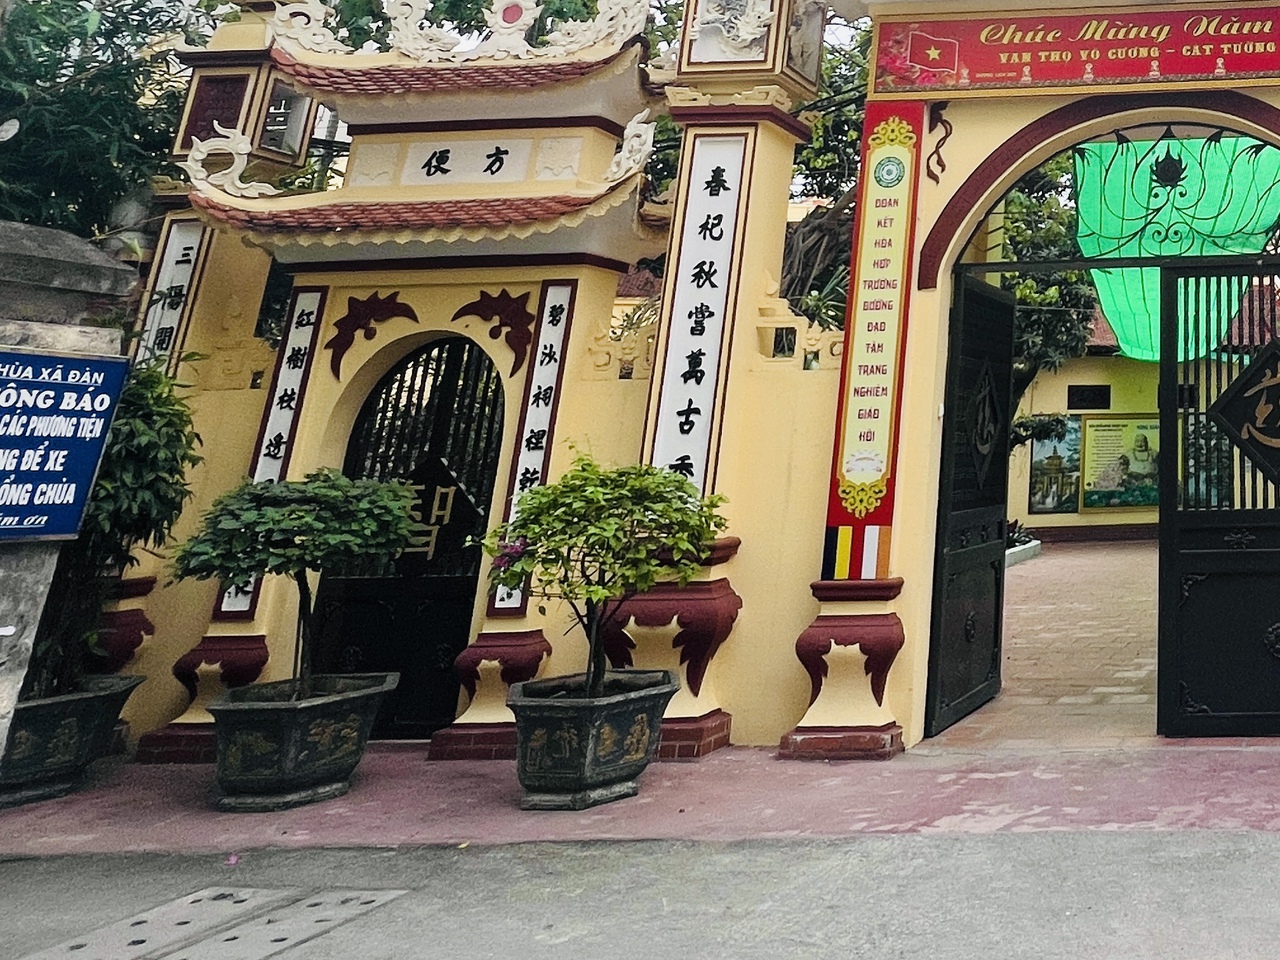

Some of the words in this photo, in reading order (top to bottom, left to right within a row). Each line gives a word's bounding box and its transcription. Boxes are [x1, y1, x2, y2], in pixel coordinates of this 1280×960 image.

[980, 23, 1063, 46] Chúc
[1068, 19, 1172, 43] Mừng
[1183, 14, 1273, 38] Năm
[38, 364, 64, 382] XÃ
[858, 364, 888, 376] TRANG
[59, 387, 111, 411] BÁO
[0, 410, 28, 436] CÁC
[25, 414, 77, 438] PHƯƠNG
[77, 413, 105, 441] TIỆN
[20, 440, 49, 471] ĐỂ
[44, 450, 68, 471] XE
